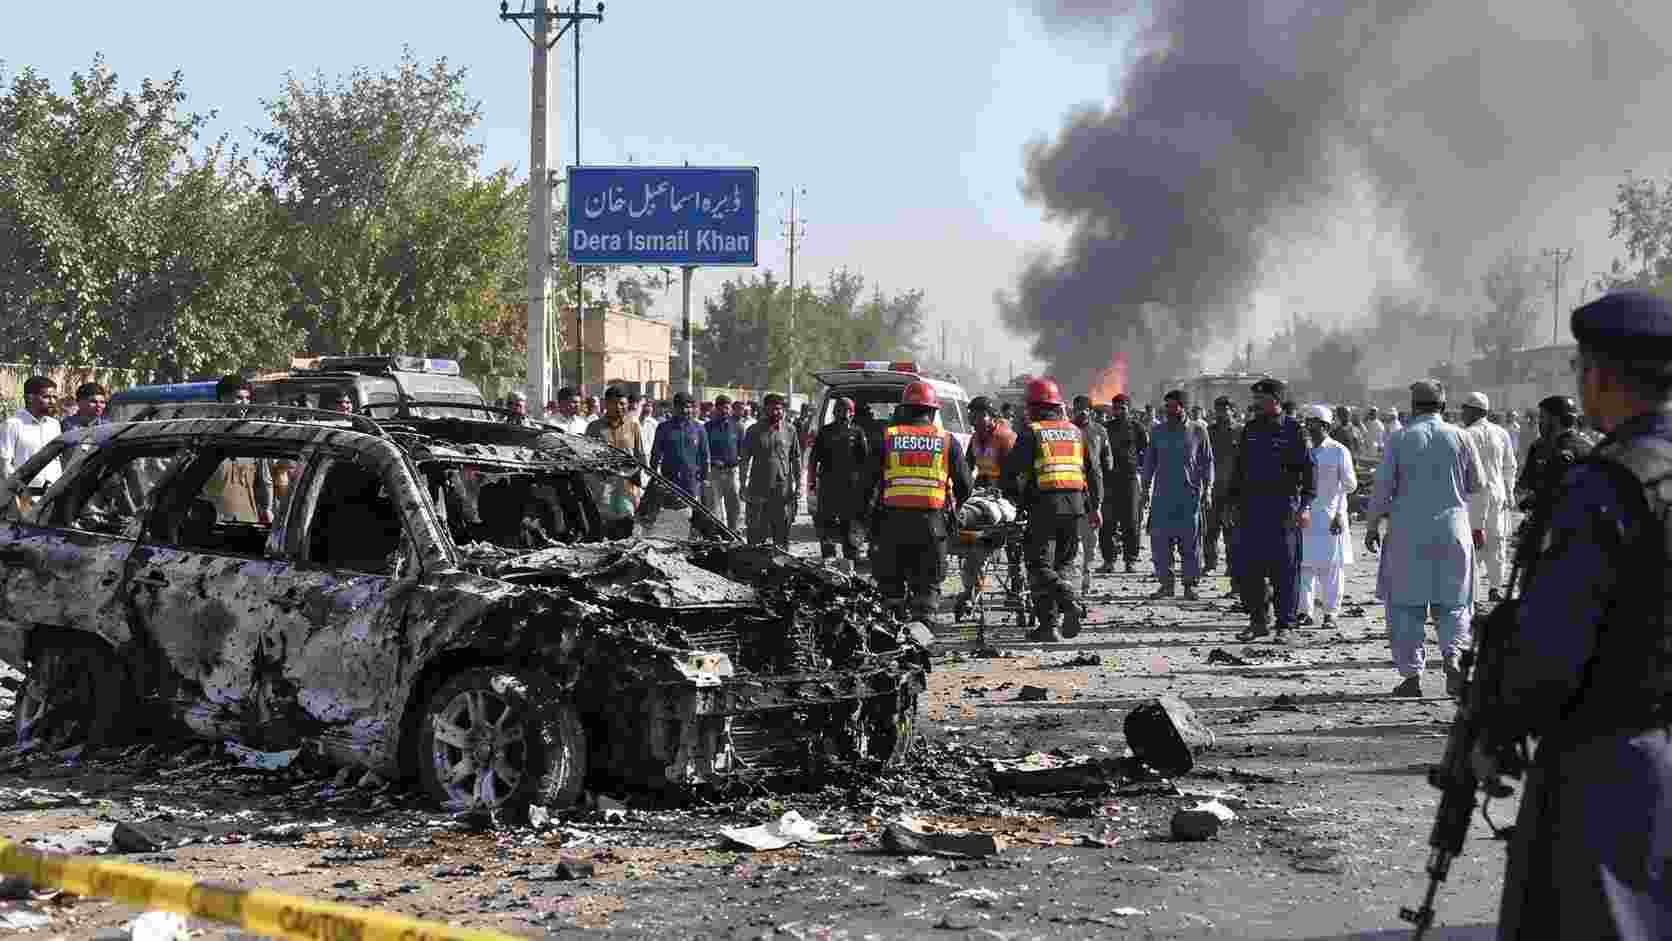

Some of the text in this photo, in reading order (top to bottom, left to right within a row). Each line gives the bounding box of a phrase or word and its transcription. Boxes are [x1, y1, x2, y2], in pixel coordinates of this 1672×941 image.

[585, 187, 625, 218] خان
[573, 229, 750, 251] Dera Ismail Khan
[894, 435, 942, 450] RESCUE
